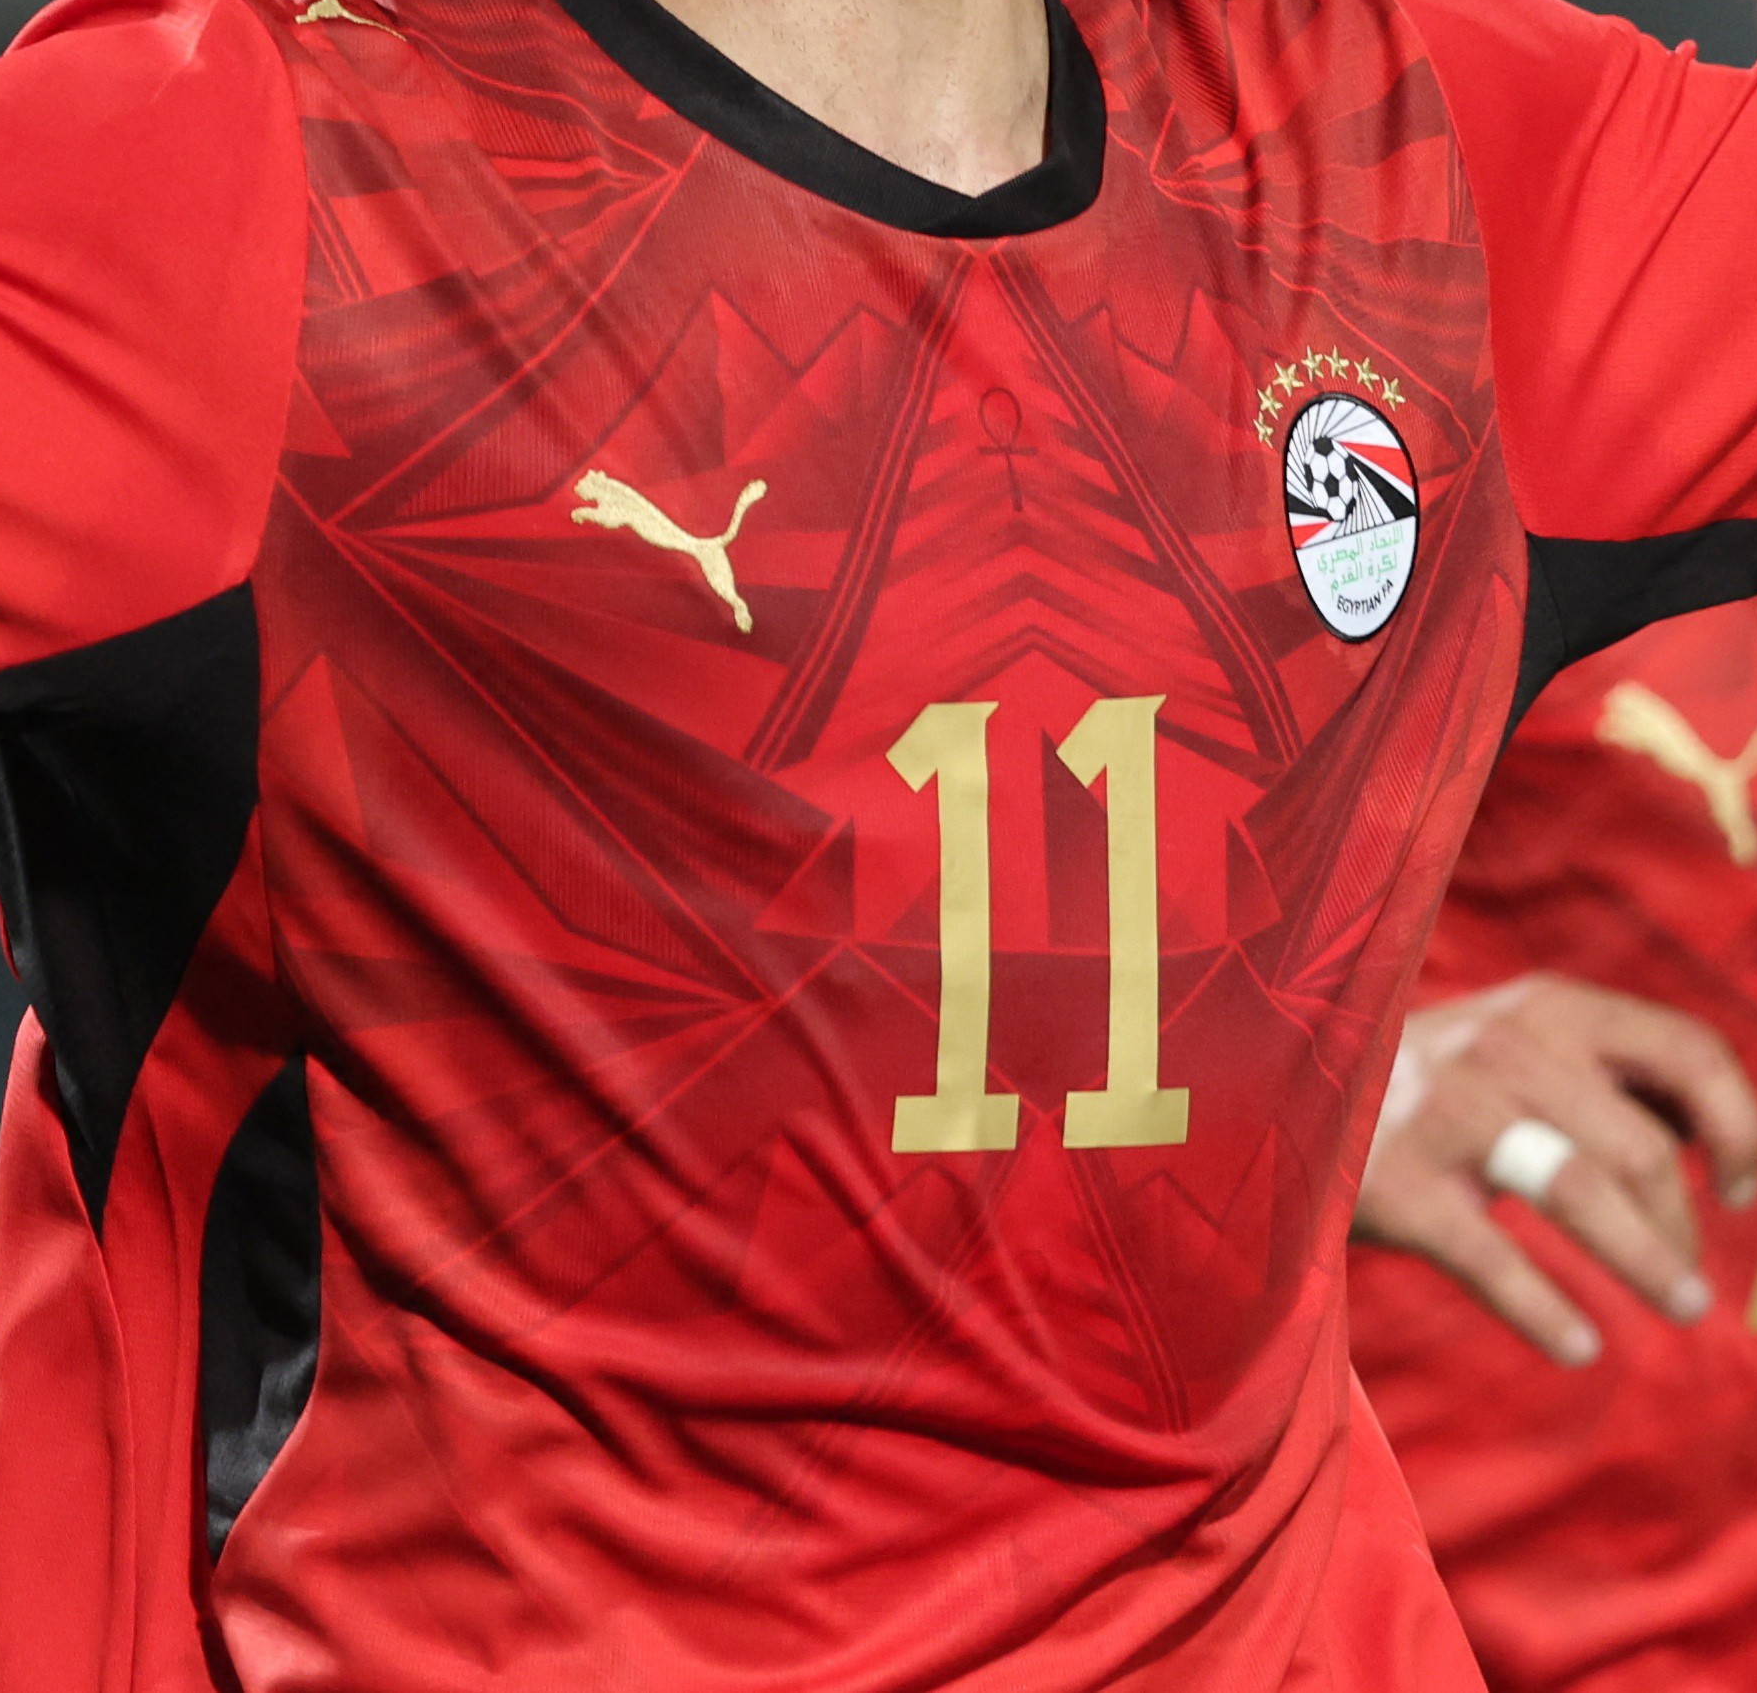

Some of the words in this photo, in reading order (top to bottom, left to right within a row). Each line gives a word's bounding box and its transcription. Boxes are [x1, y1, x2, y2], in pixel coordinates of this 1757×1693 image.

[1331, 560, 1362, 600] القدم
[1337, 593, 1381, 615] EGYPTIAN
[1381, 578, 1394, 599] FA
[886, 694, 1190, 1153] 11
